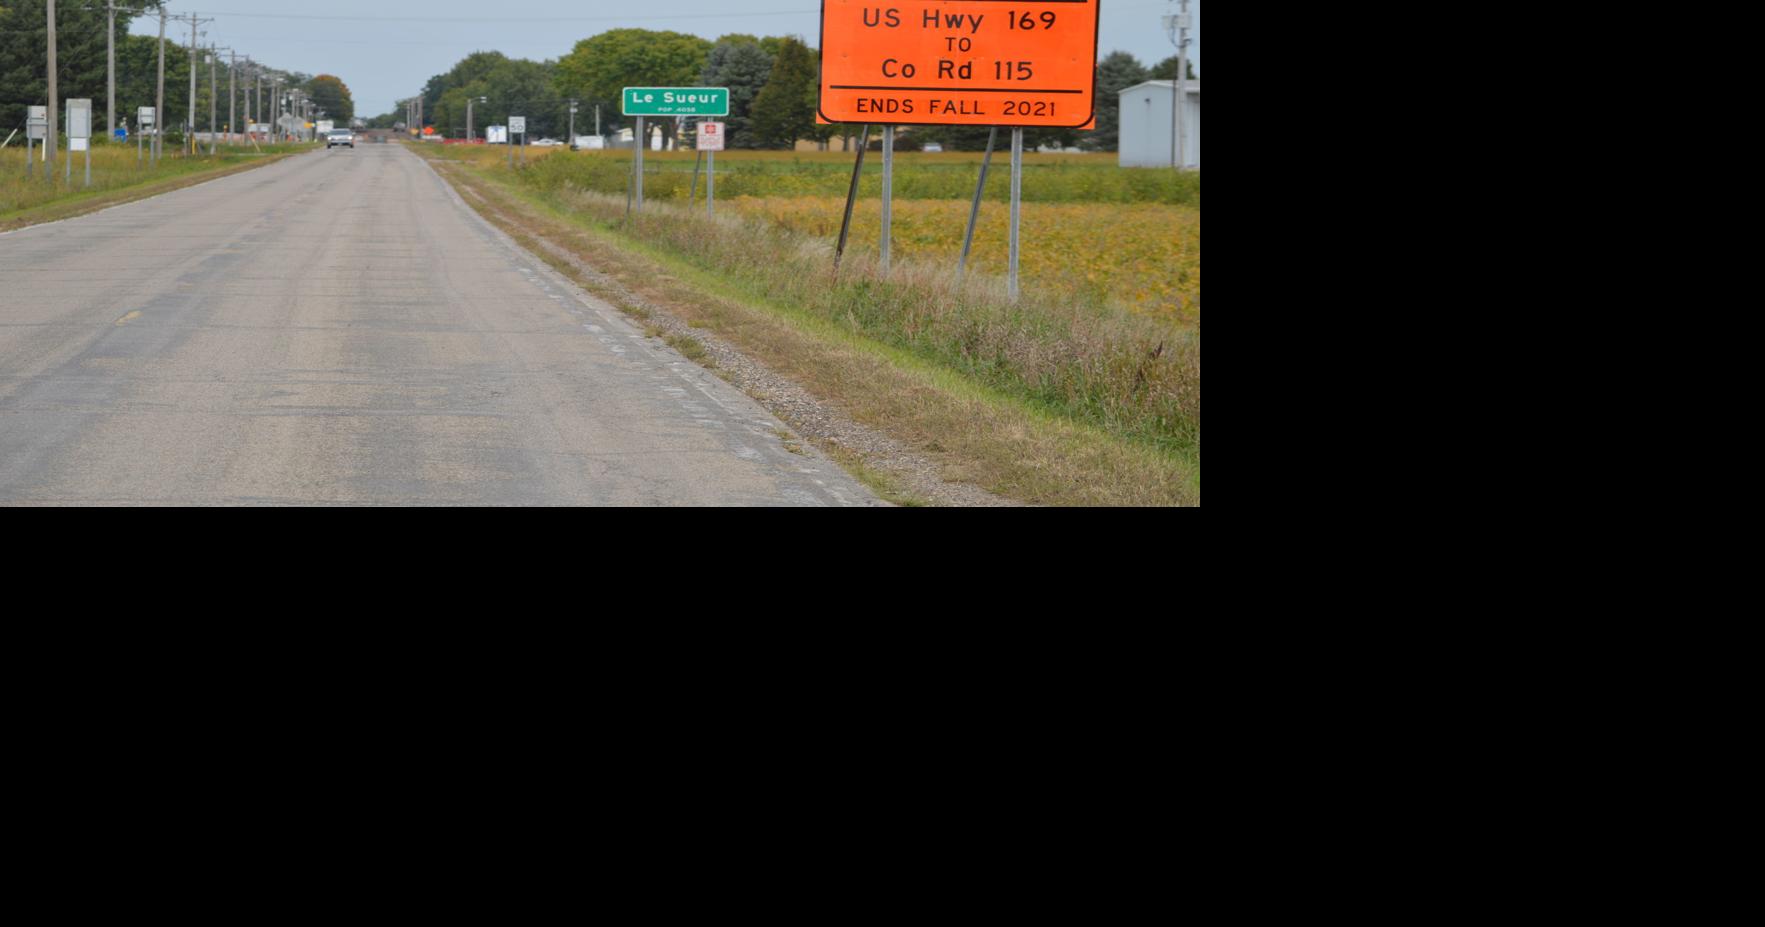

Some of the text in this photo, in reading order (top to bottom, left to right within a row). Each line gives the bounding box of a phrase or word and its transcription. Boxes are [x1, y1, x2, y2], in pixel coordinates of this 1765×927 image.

[863, 7, 1057, 34] US Hwy 169
[944, 36, 972, 53] TO
[881, 58, 1034, 81] Co Rd 115
[632, 92, 719, 104] Le Sueur
[856, 97, 1055, 117] ENDS FALL 2021
